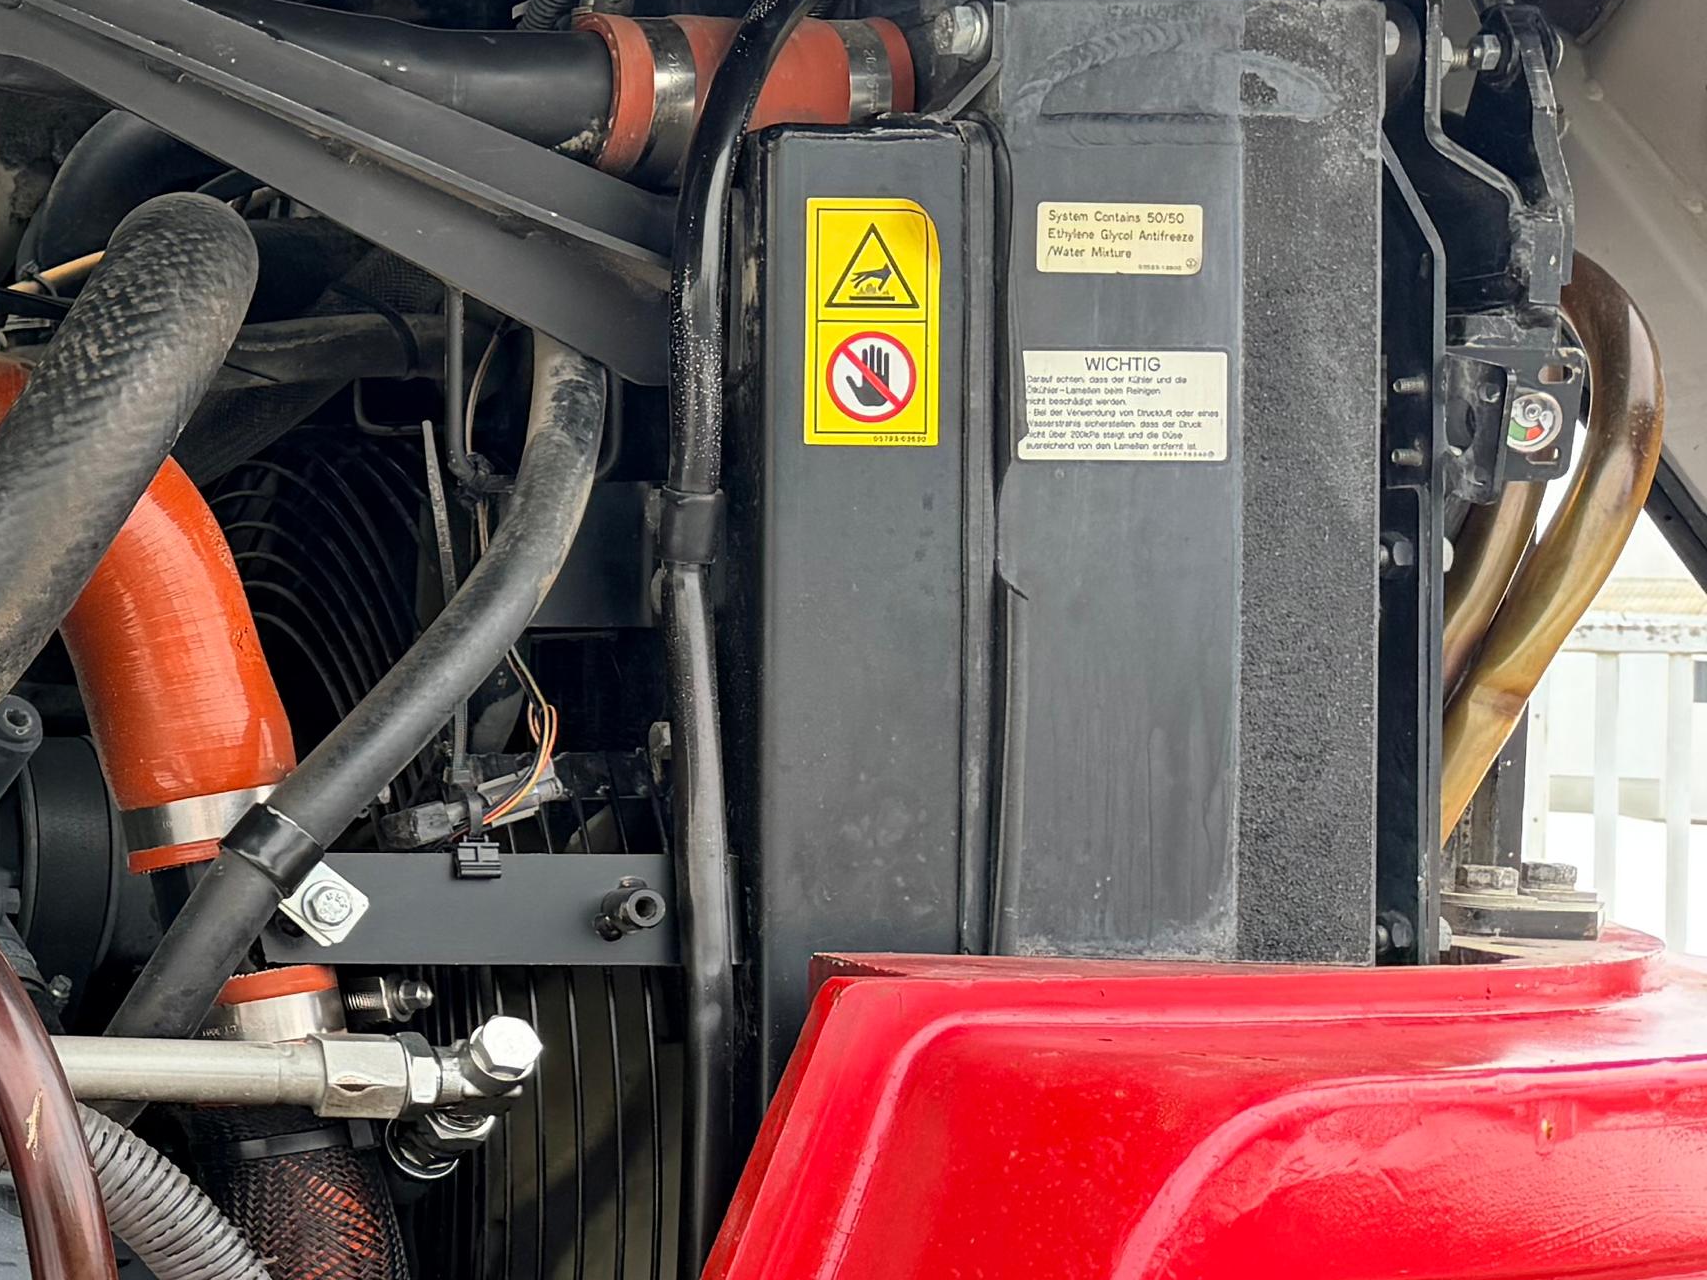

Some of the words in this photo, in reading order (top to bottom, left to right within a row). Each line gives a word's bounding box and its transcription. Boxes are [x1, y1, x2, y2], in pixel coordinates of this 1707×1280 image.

[1048, 209, 1088, 223] System
[1095, 211, 1140, 223] Contains
[1147, 212, 1184, 225] 50/50
[1048, 228, 1094, 241] Ethylene
[1101, 229, 1133, 242] Glycol
[1139, 230, 1194, 242] Antifreeze
[1047, 246, 1086, 257] /Water
[1091, 247, 1131, 259] Mixture
[1085, 356, 1161, 372] WICHTIG
[1112, 375, 1124, 385] der
[1157, 375, 1171, 385] und
[1175, 375, 1186, 385] die
[1051, 409, 1062, 418] der
[1120, 409, 1133, 418] von
[1176, 409, 1194, 418] oder
[1198, 409, 1218, 418] eines
[1162, 420, 1175, 429] der
[1179, 420, 1201, 429] Druck
[1128, 430, 1143, 440] und
[1147, 430, 1159, 440] die
[1078, 442, 1092, 451] von
[1096, 442, 1110, 451] den
